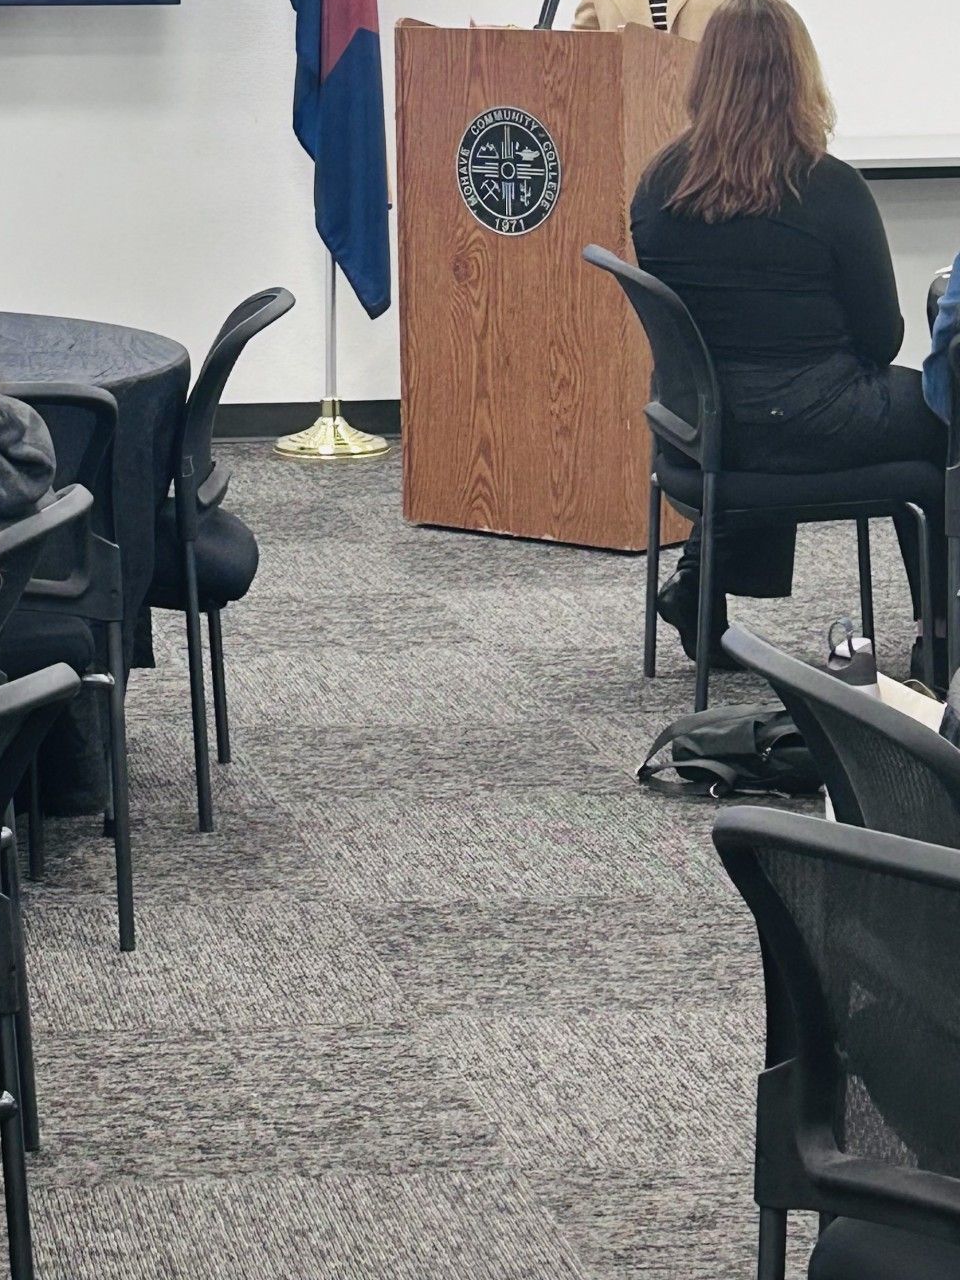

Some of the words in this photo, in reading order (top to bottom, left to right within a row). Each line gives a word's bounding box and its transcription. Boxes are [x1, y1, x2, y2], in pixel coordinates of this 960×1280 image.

[458, 147, 478, 207] MOHAVE
[470, 109, 539, 135] COMMUNITY
[541, 141, 557, 210] COLLEGE
[494, 218, 526, 233] 1971
